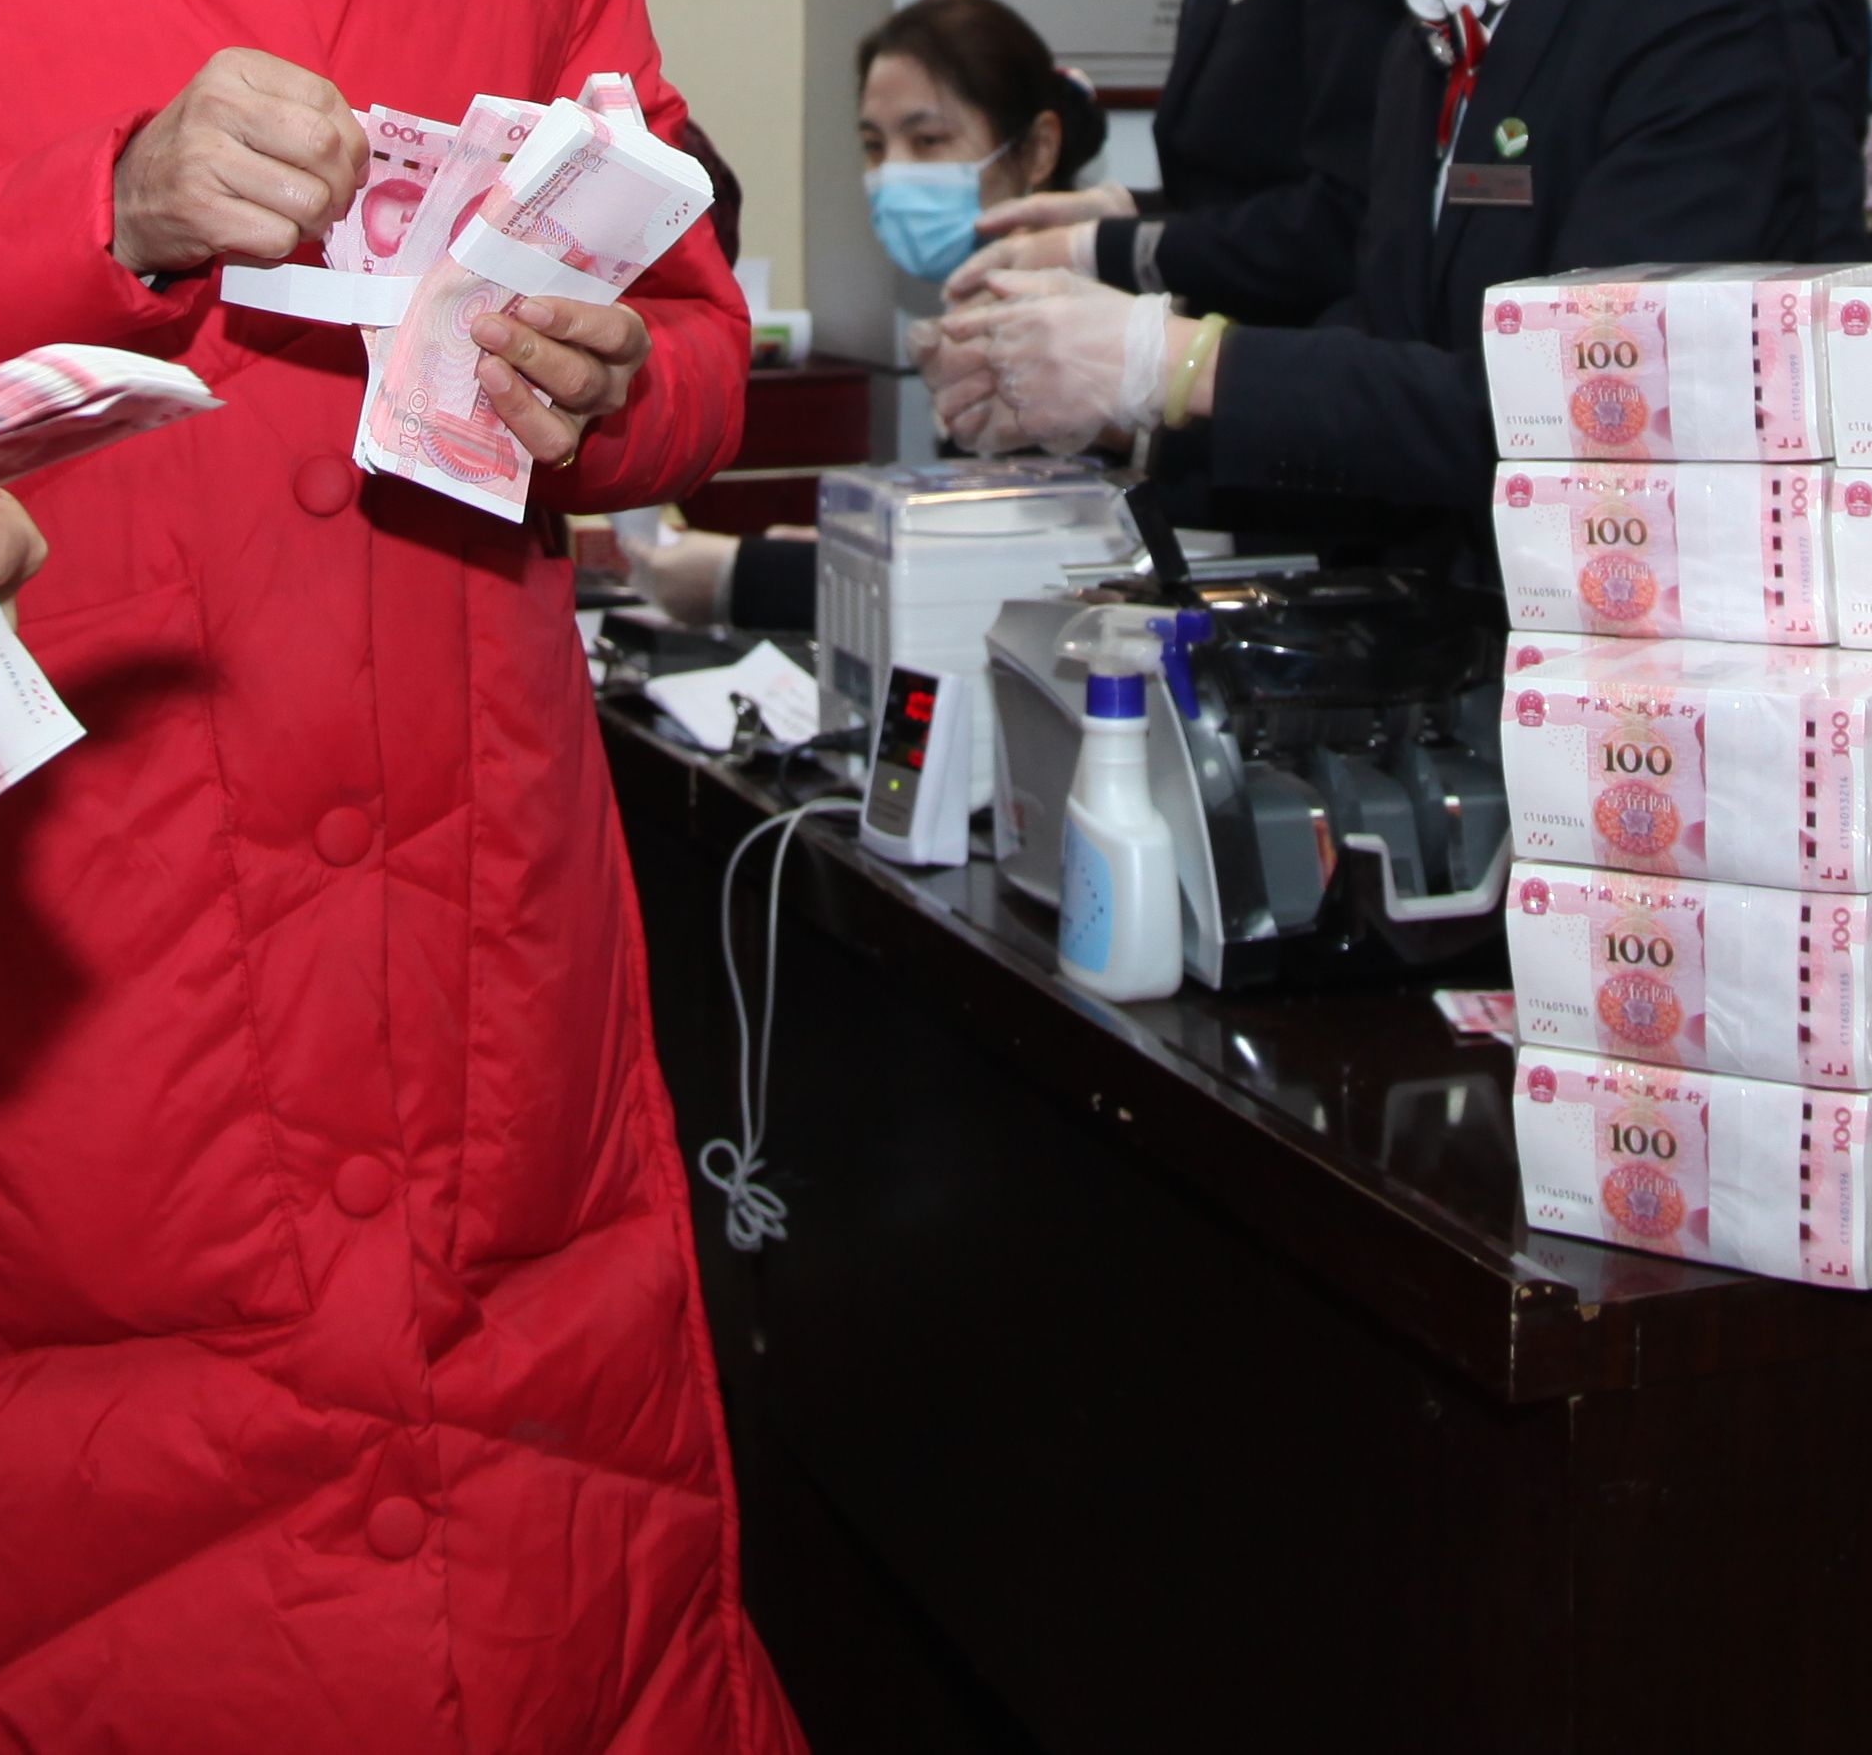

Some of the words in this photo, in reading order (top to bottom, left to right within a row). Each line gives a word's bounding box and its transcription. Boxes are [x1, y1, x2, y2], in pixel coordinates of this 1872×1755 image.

[1780, 293, 1798, 335] 100
[1574, 340, 1639, 370] 100
[1791, 476, 1809, 519] 100
[1583, 516, 1648, 546] 100
[1831, 710, 1851, 759] 100
[1602, 742, 1673, 777] 100
[1604, 932, 1675, 968] 100
[1831, 907, 1852, 955] 100
[1609, 1122, 1678, 1160] 100
[1832, 1107, 1852, 1155] 100
